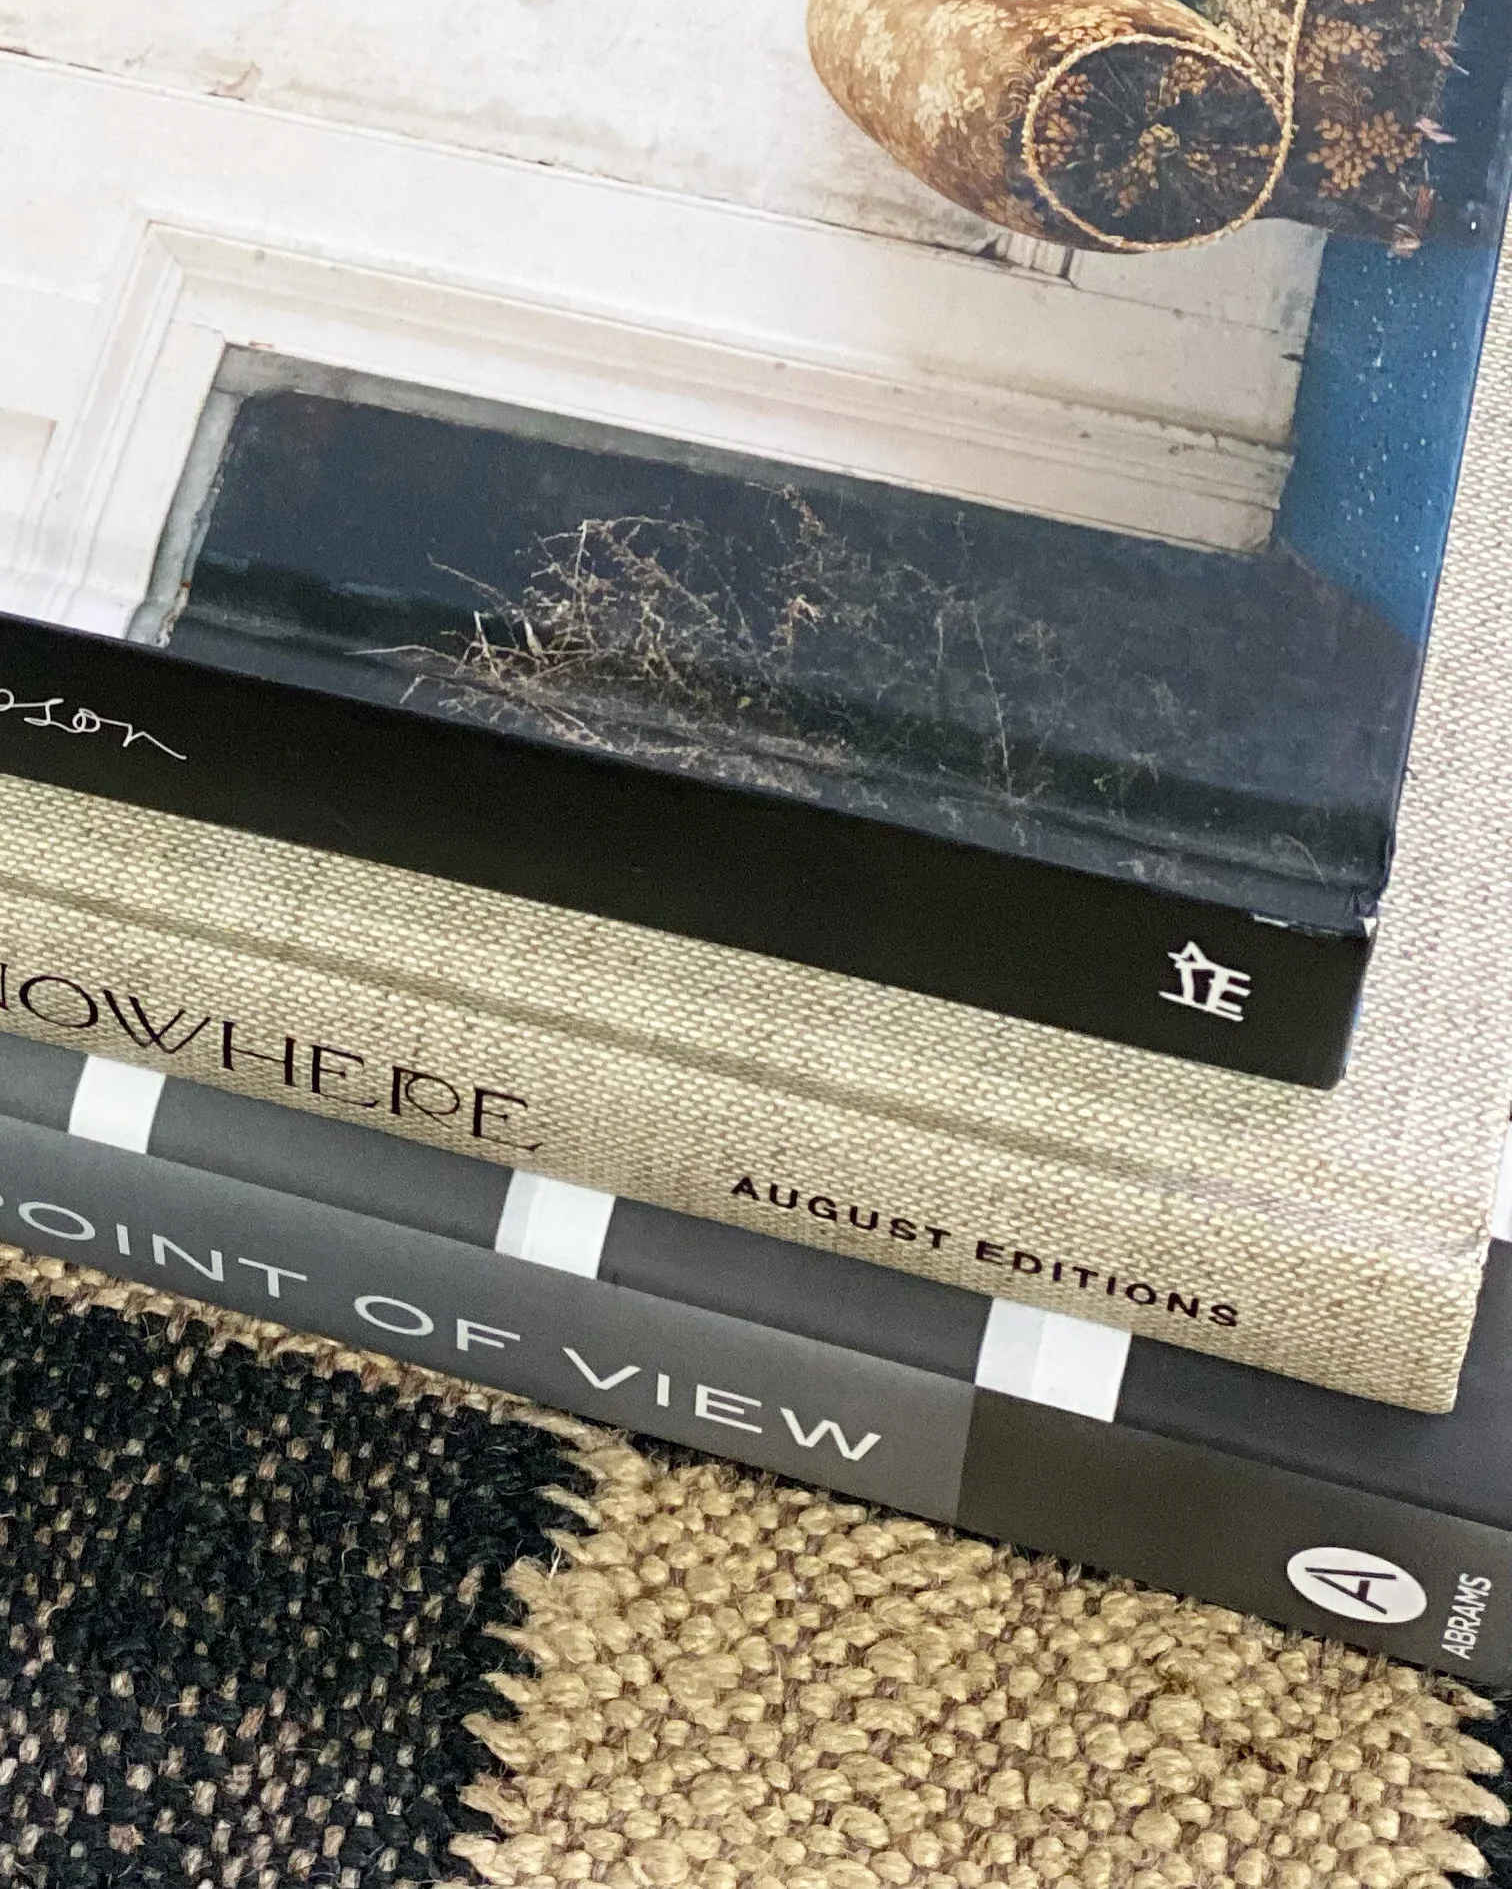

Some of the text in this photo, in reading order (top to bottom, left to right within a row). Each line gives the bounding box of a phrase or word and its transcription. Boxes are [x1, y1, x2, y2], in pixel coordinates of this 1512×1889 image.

[730, 1176, 1240, 1327] AUGUST EDITIONS
[354, 1295, 521, 1352] OF
[563, 1346, 882, 1462] VIEW
[1441, 1572, 1492, 1660] ABRAMS
